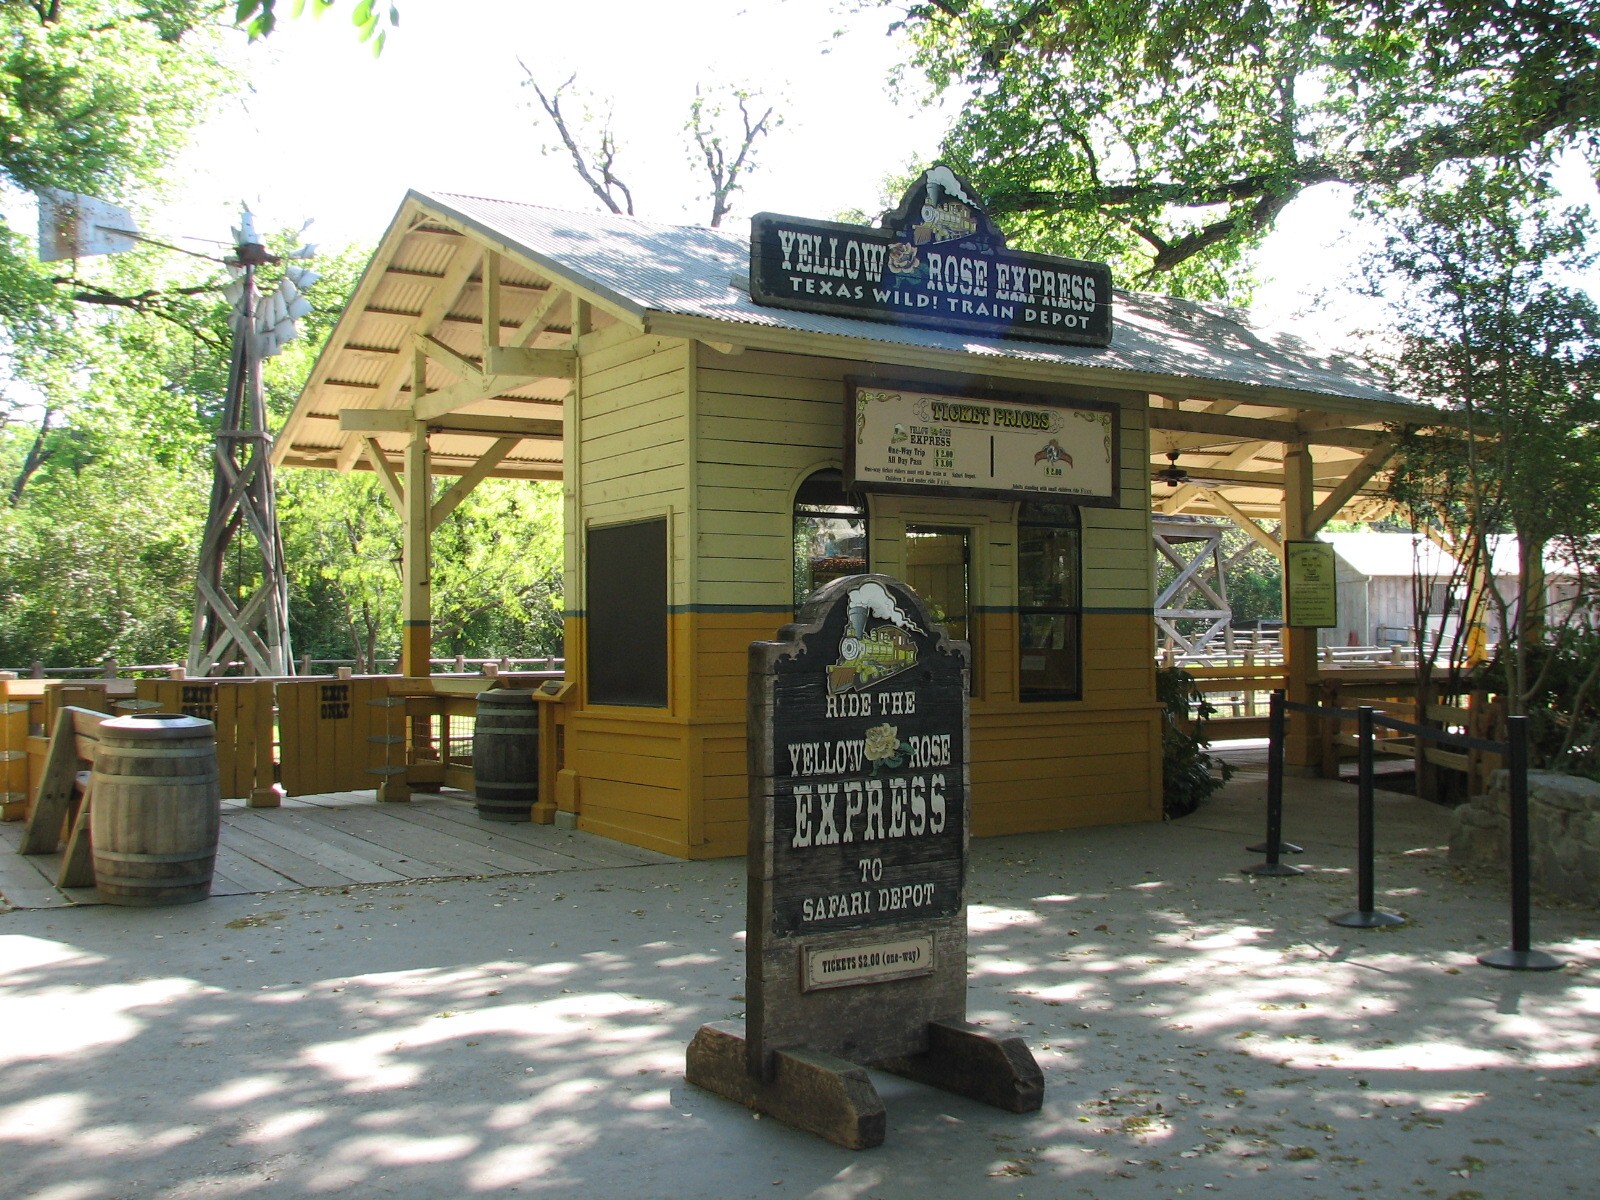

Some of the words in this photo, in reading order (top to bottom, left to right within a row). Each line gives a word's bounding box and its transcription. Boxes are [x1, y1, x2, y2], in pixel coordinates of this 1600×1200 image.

[778, 230, 886, 283] YELLOW
[926, 252, 988, 297] ROSE
[995, 263, 1096, 313] EXPRESS
[789, 276, 865, 301] TEXAS
[872, 288, 938, 310] WILD!
[947, 297, 1015, 320] TRAIN
[1024, 308, 1090, 330] DEPOT
[931, 402, 990, 424] TICKET
[993, 408, 1050, 430] PRICES
[888, 446, 913, 456] One-Way
[914, 447, 926, 457] Trip
[910, 435, 951, 447] EXPRESS
[888, 456, 896, 464] All
[898, 456, 908, 466] Day
[910, 458, 922, 466] Pass
[182, 686, 212, 703] EXIT
[321, 685, 349, 702] EXIT
[825, 693, 872, 718] RIDE
[878, 691, 916, 715] THE
[320, 703, 350, 720] ONLY
[787, 739, 866, 777] YELLOW
[909, 734, 951, 769] ROSE
[792, 773, 947, 848] EXPRESS
[858, 858, 883, 882] TO
[802, 890, 871, 922] SAFARI
[878, 883, 935, 912] DEPOT
[821, 955, 857, 974] TICKETS
[858, 952, 880, 969] $2.00
[882, 946, 921, 966] (one-way)
